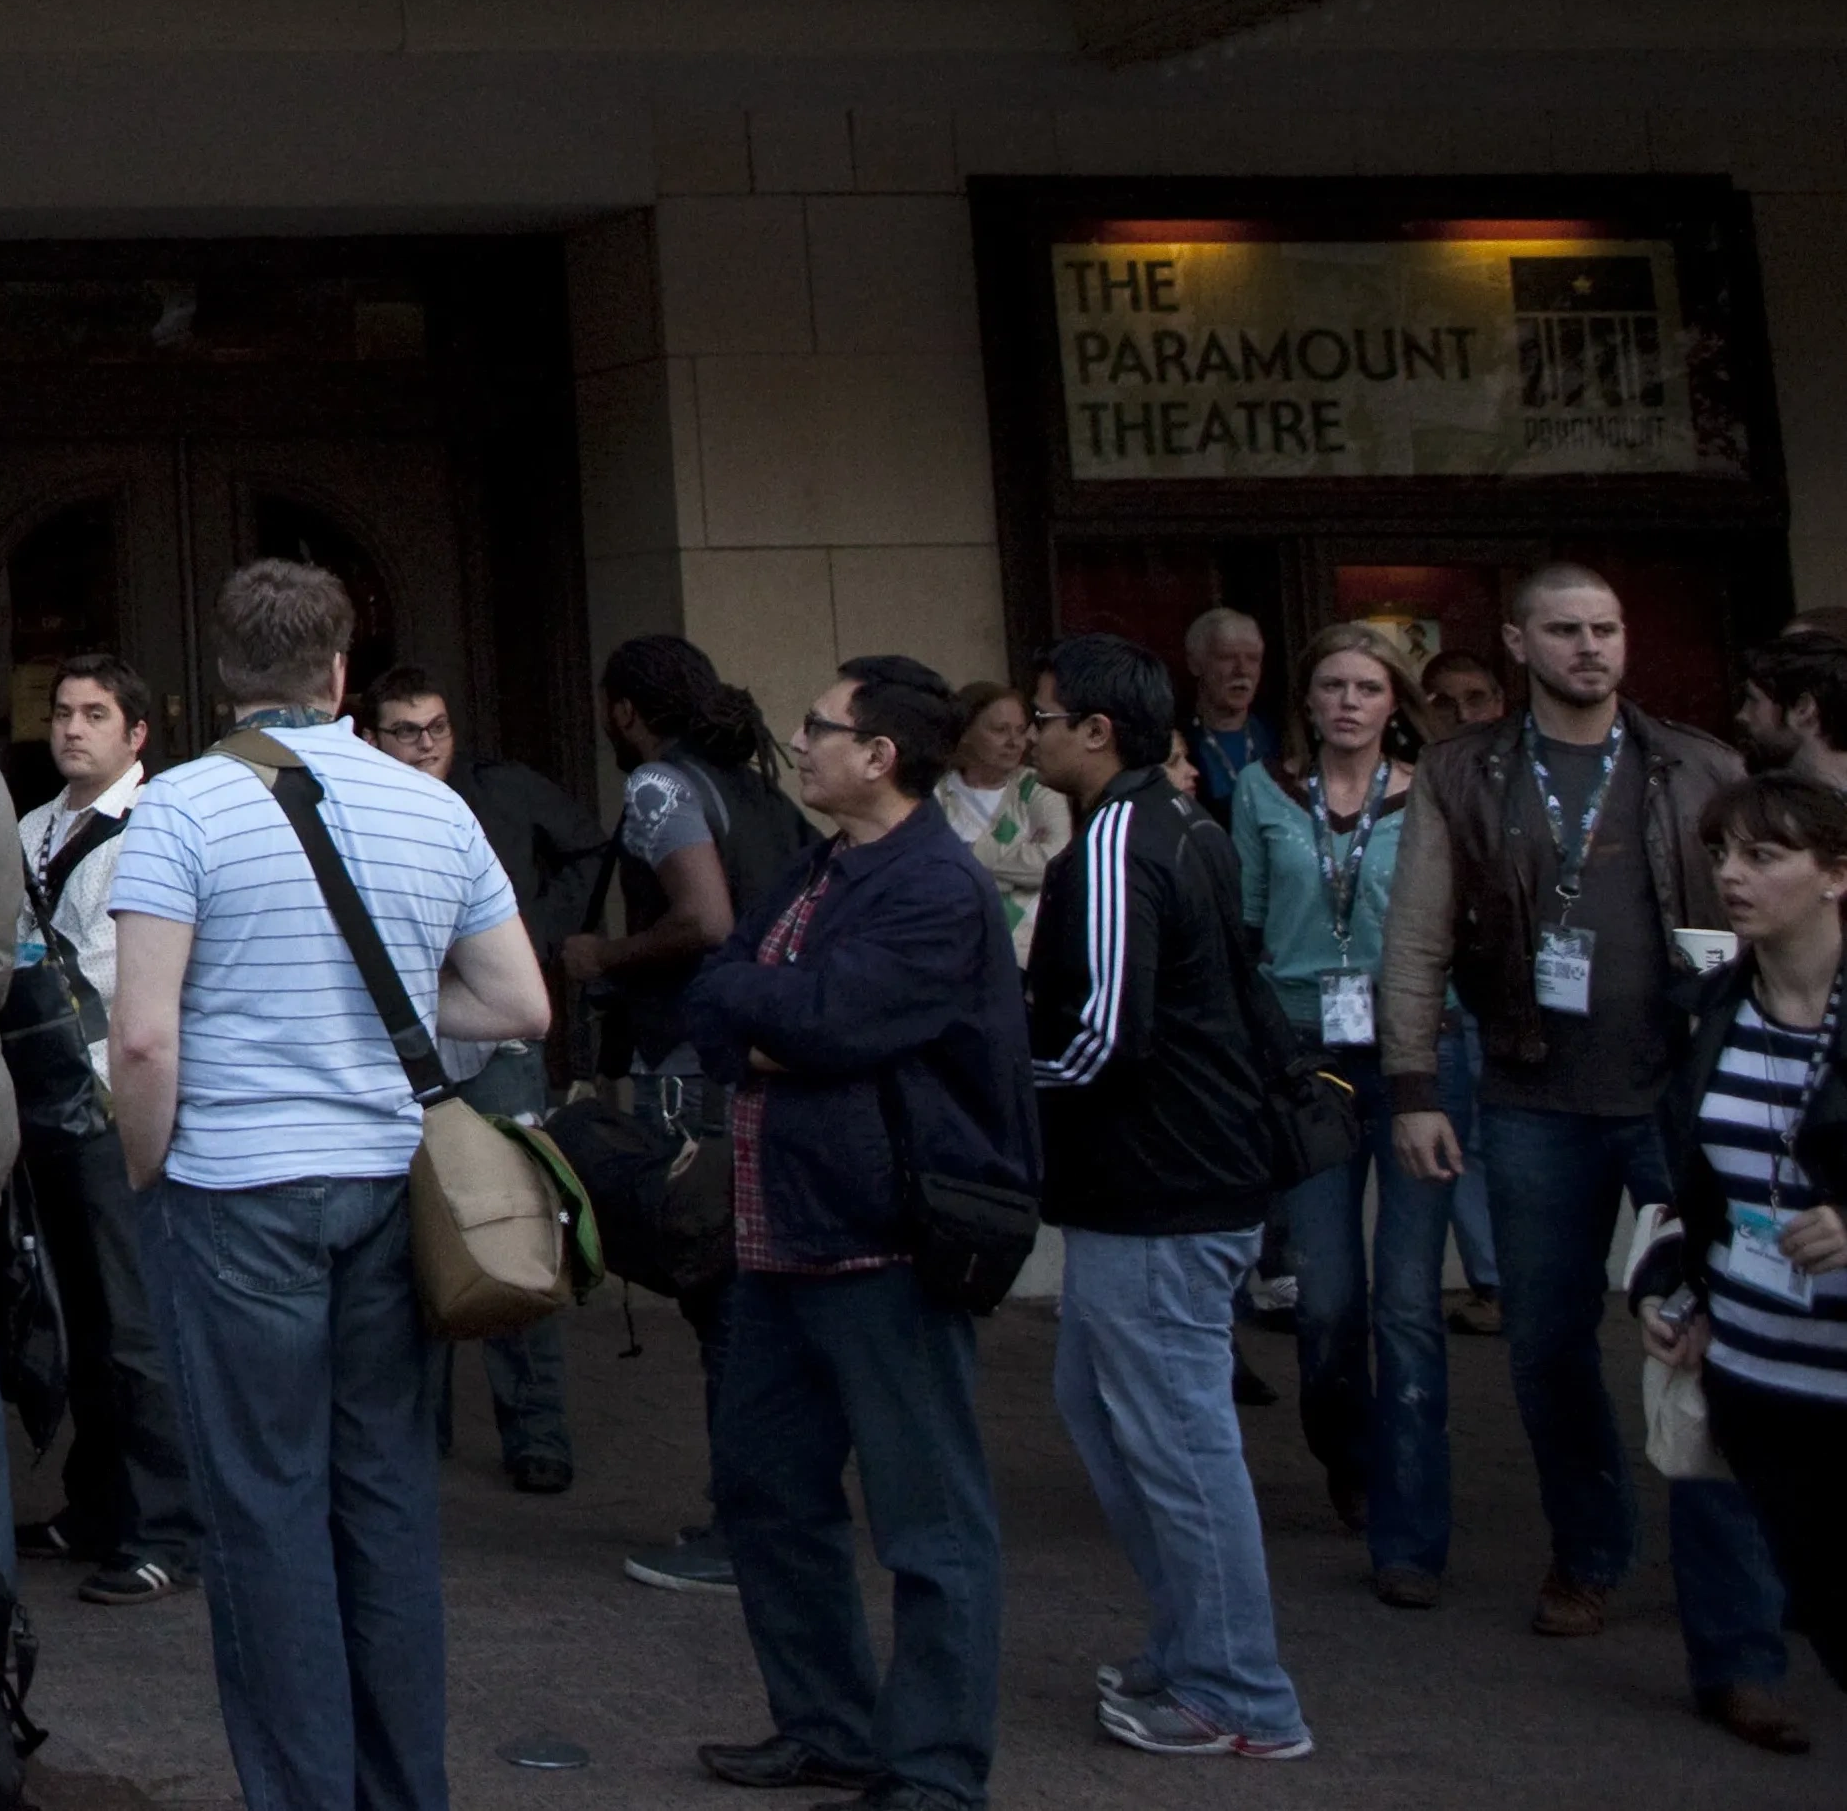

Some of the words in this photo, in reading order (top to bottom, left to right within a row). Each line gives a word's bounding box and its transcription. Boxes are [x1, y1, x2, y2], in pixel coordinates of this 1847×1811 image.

[1064, 261, 1180, 313] THE
[1076, 328, 1478, 384] PARAMOUNT
[1079, 400, 1347, 455] THEATRE
